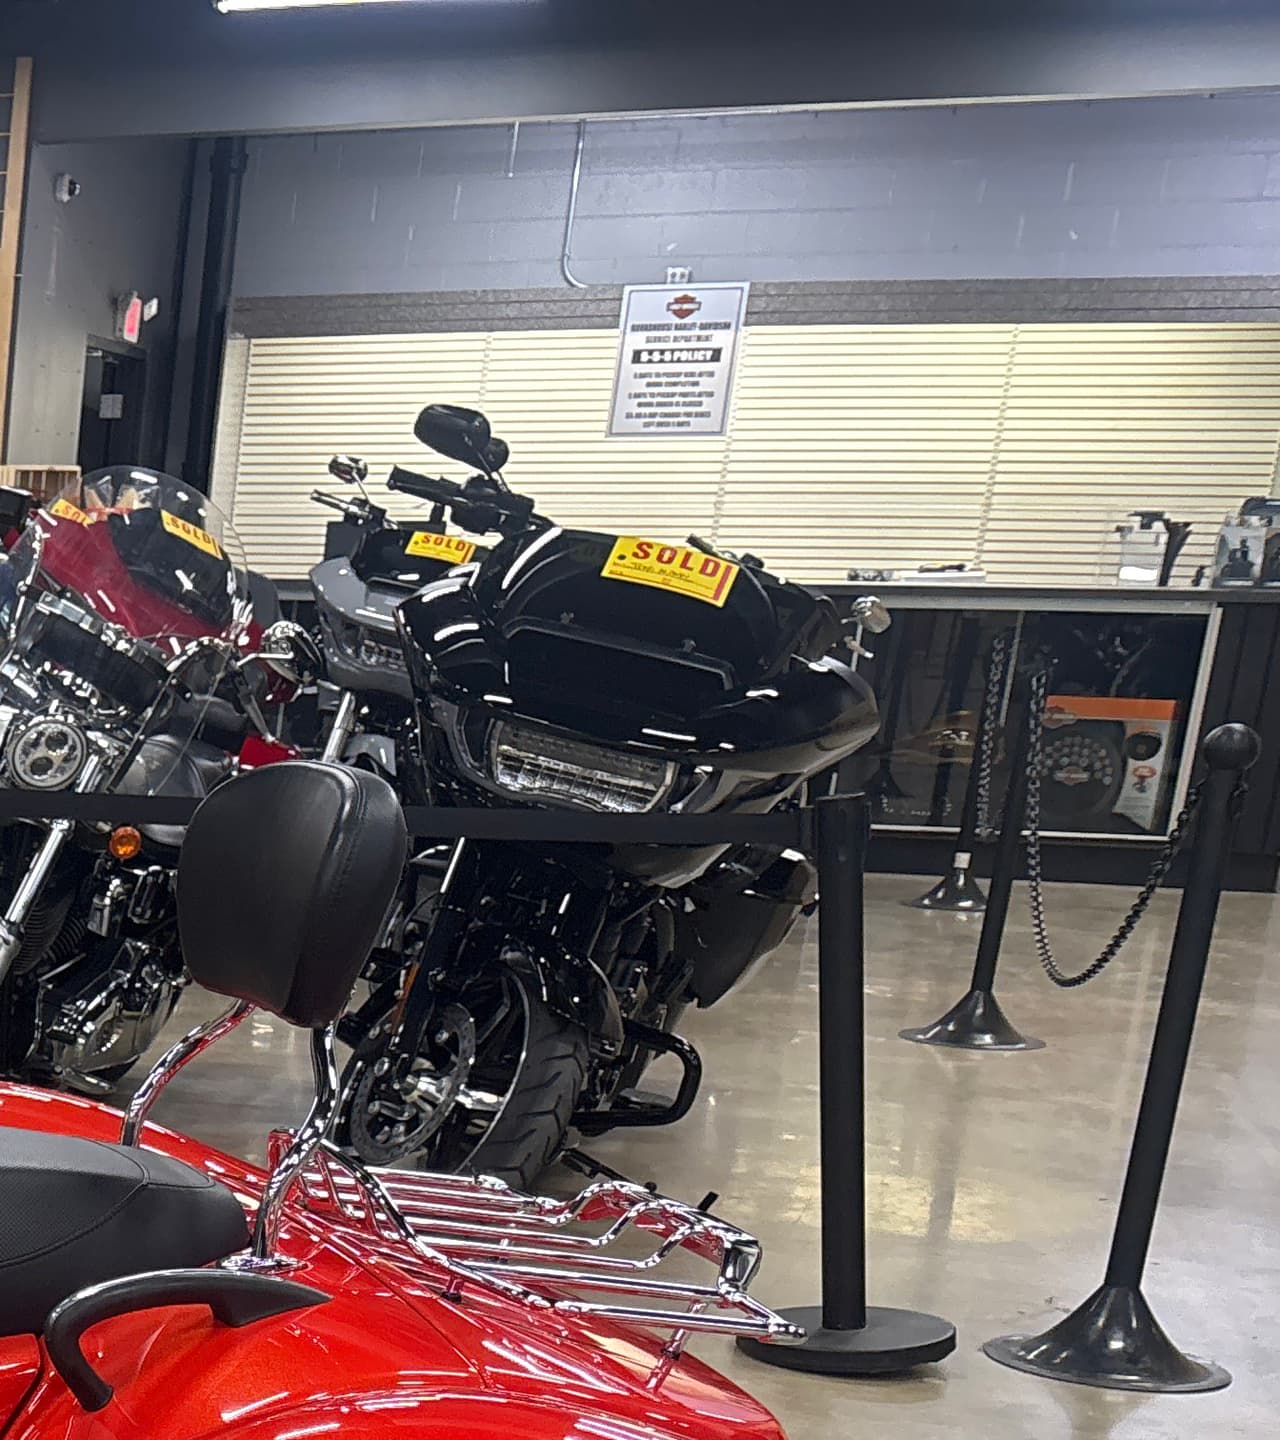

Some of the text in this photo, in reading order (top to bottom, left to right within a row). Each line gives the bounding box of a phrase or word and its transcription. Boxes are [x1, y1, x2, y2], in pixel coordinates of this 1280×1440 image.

[673, 350, 713, 361] POLICY
[171, 517, 211, 545] SOLD
[422, 535, 466, 552] SOLD
[632, 541, 721, 578] SOLD
